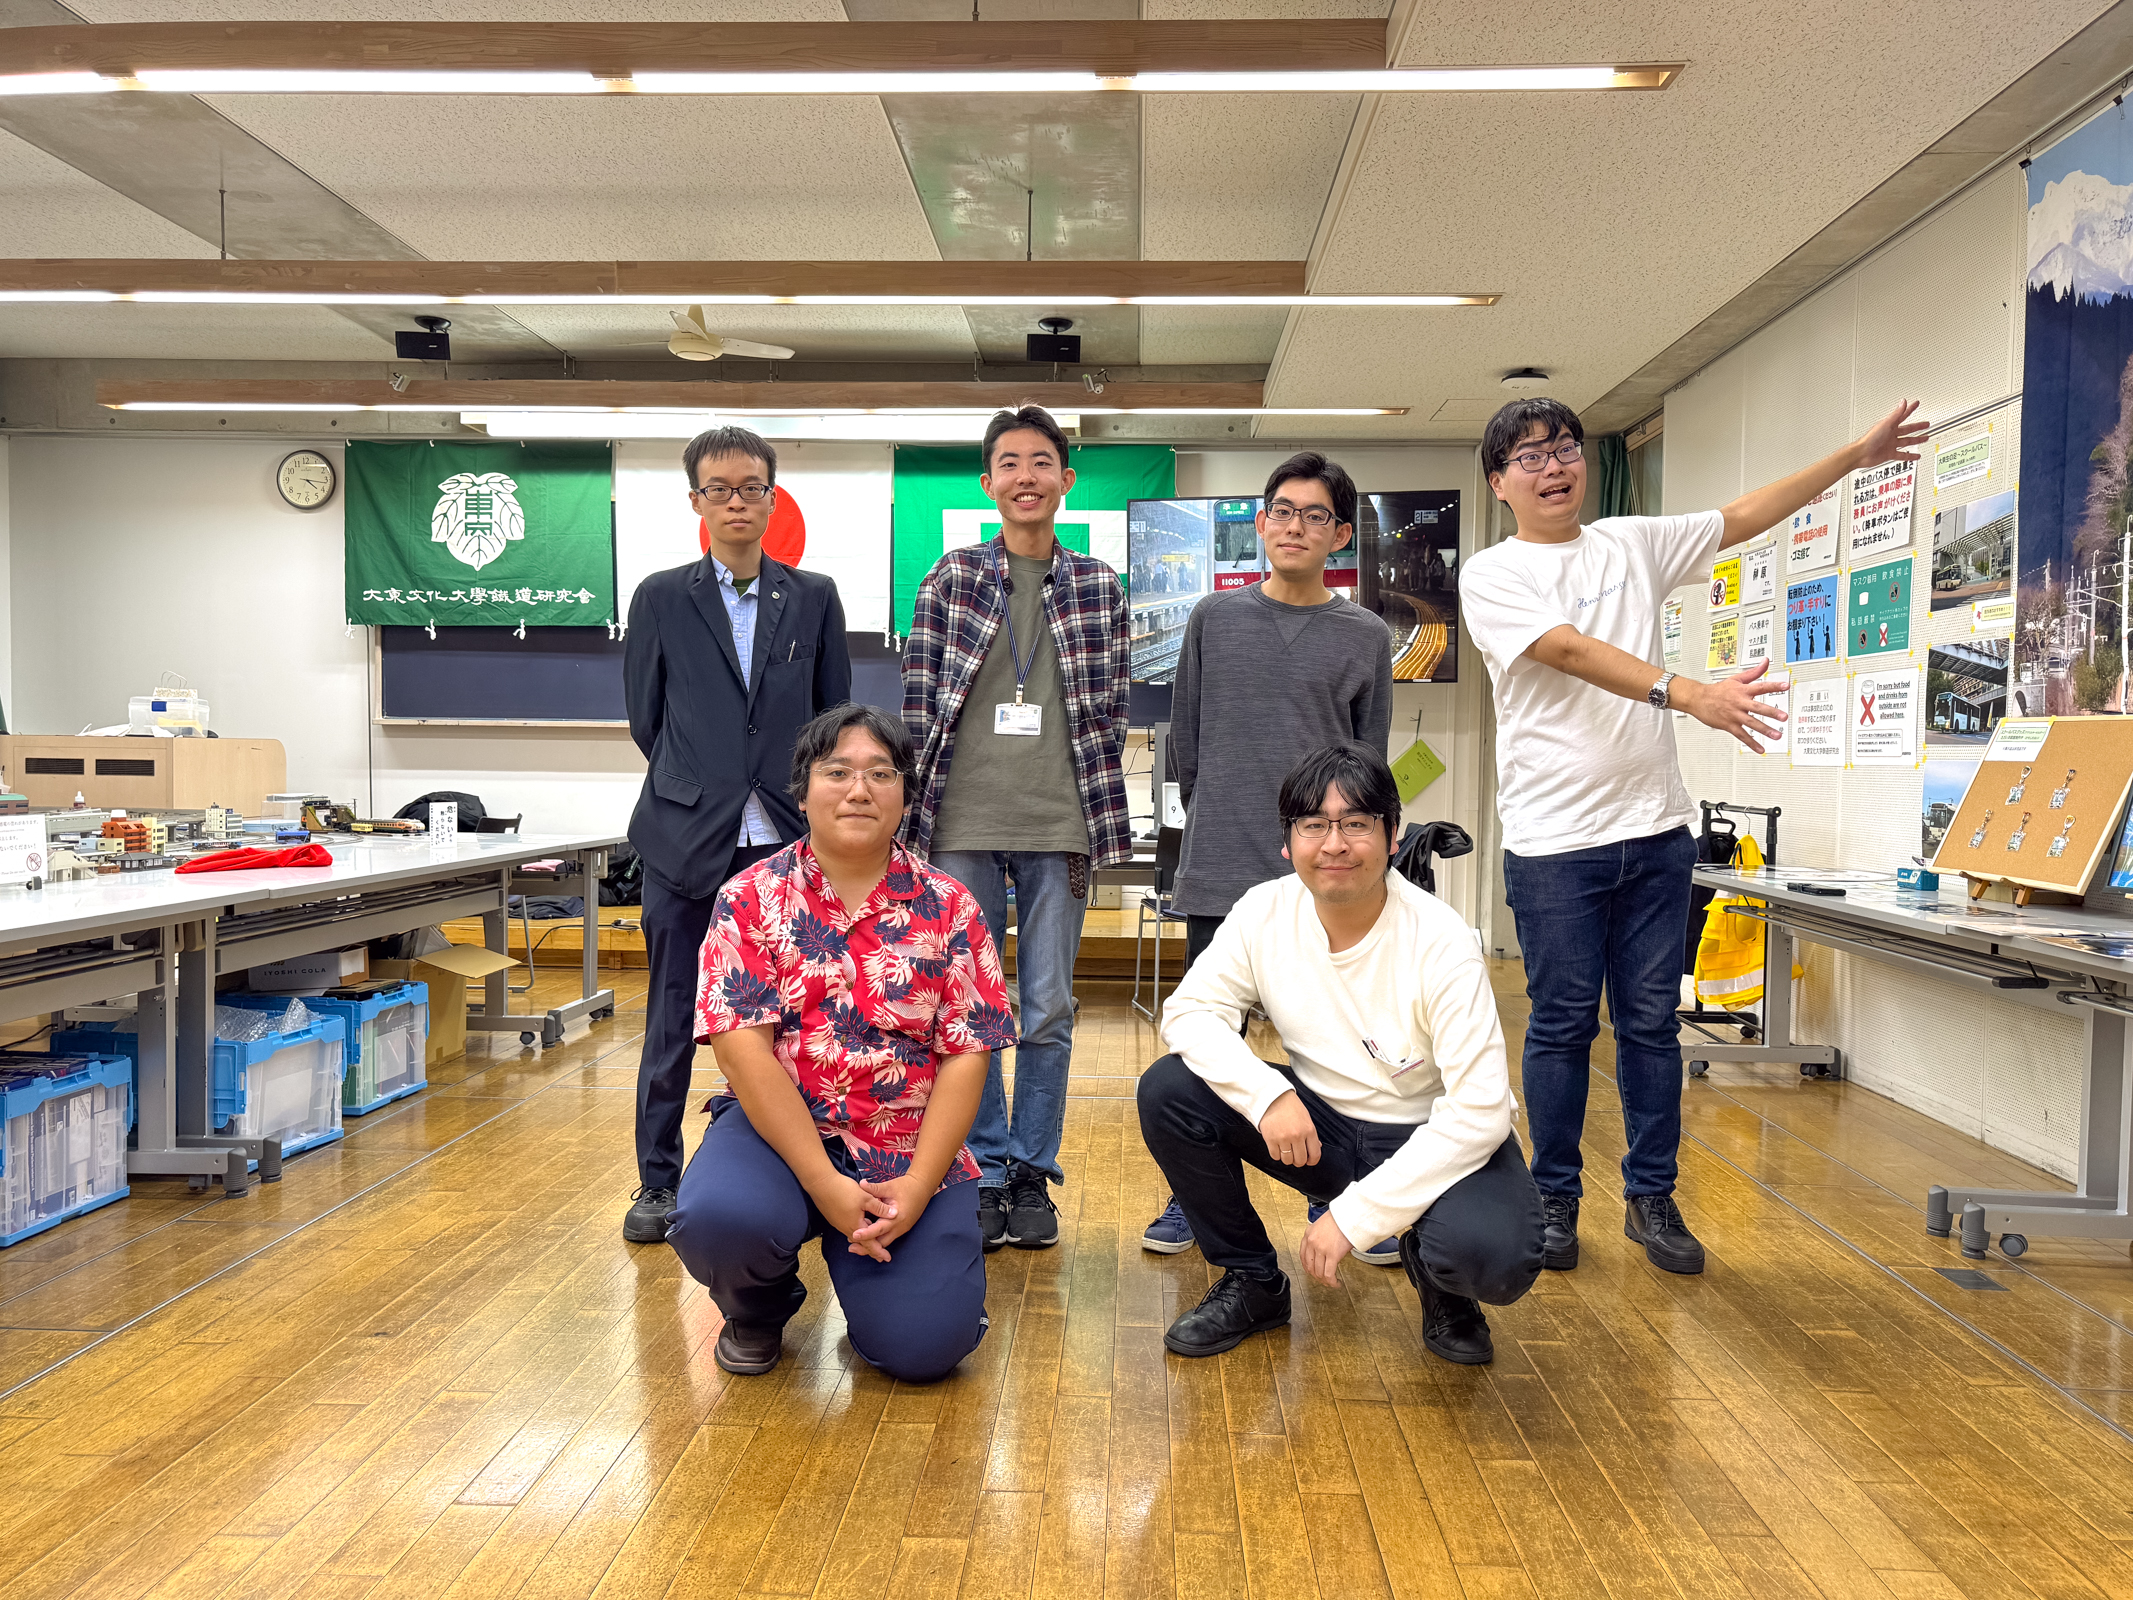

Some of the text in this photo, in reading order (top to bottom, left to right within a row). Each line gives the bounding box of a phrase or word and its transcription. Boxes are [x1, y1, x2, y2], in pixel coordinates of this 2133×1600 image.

[294, 459, 301, 468] 11
[303, 457, 310, 465] 12
[285, 476, 290, 484] 9
[297, 492, 302, 500] 7
[314, 492, 319, 500] 5
[1881, 565, 1909, 581] 飲食禁止
[1221, 577, 1245, 586] 11005
[1852, 573, 1877, 587] マスク着用
[1900, 680, 1910, 688] food
[1878, 692, 1886, 700] and
[1886, 691, 1897, 699] drinks
